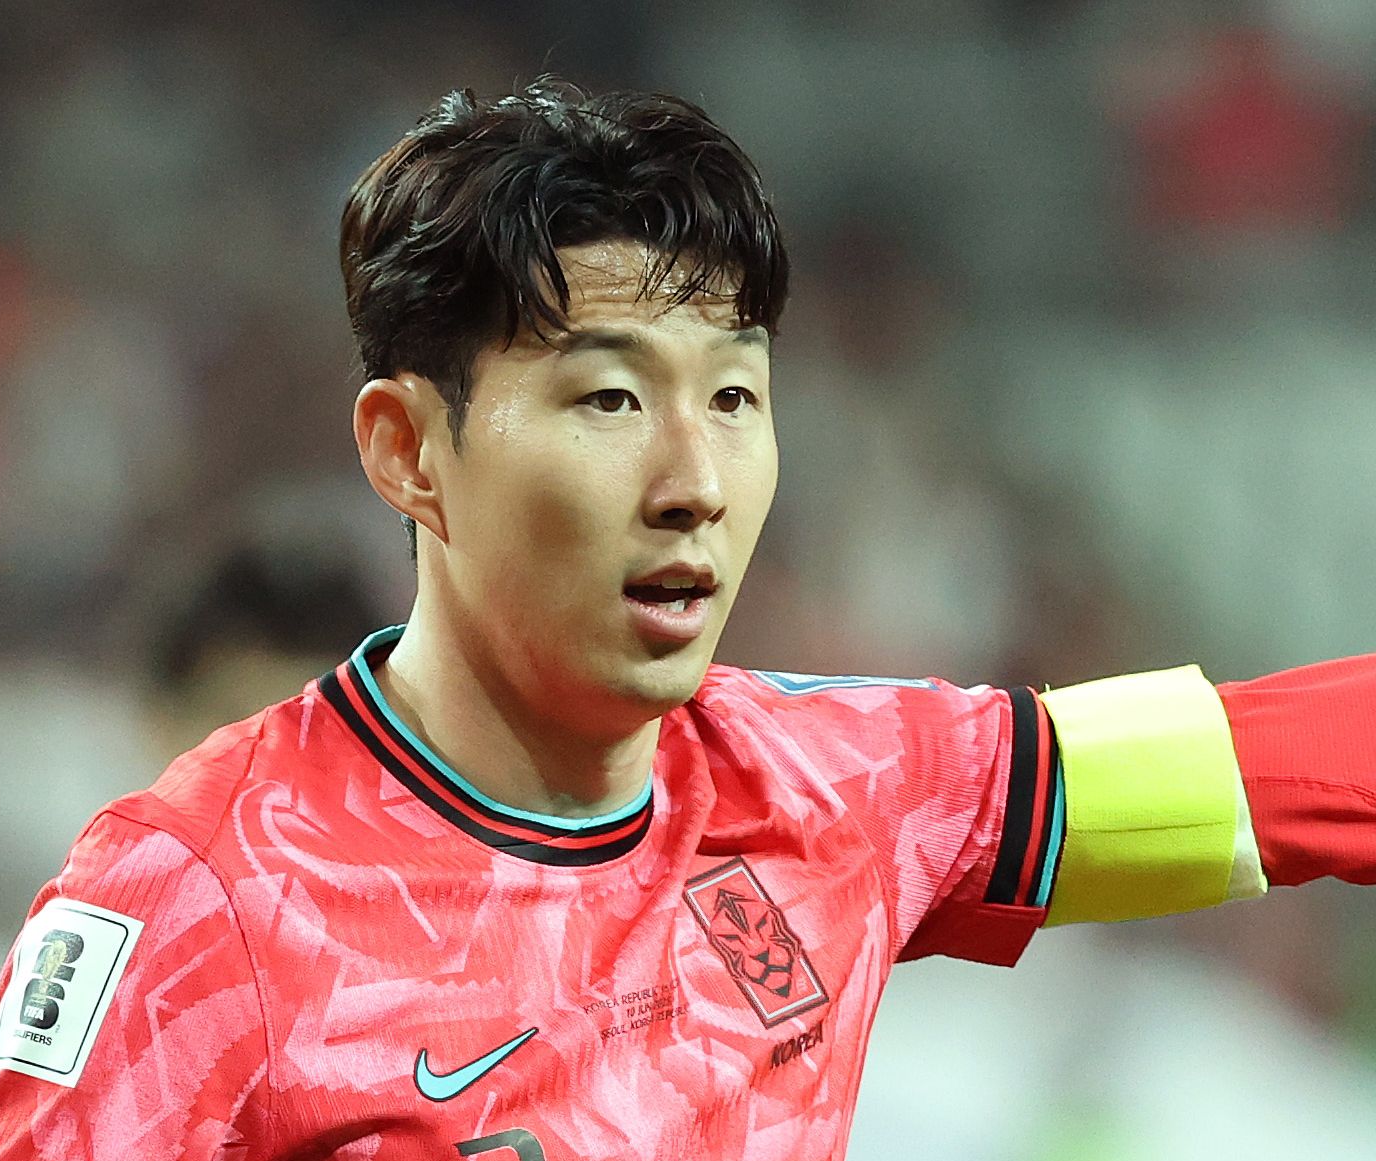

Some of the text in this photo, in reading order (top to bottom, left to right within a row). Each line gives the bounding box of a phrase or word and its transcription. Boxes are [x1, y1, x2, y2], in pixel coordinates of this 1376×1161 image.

[24, 1005, 44, 1021] FIFA
[583, 997, 619, 1015] KOREA
[769, 1019, 823, 1071] KOREA
